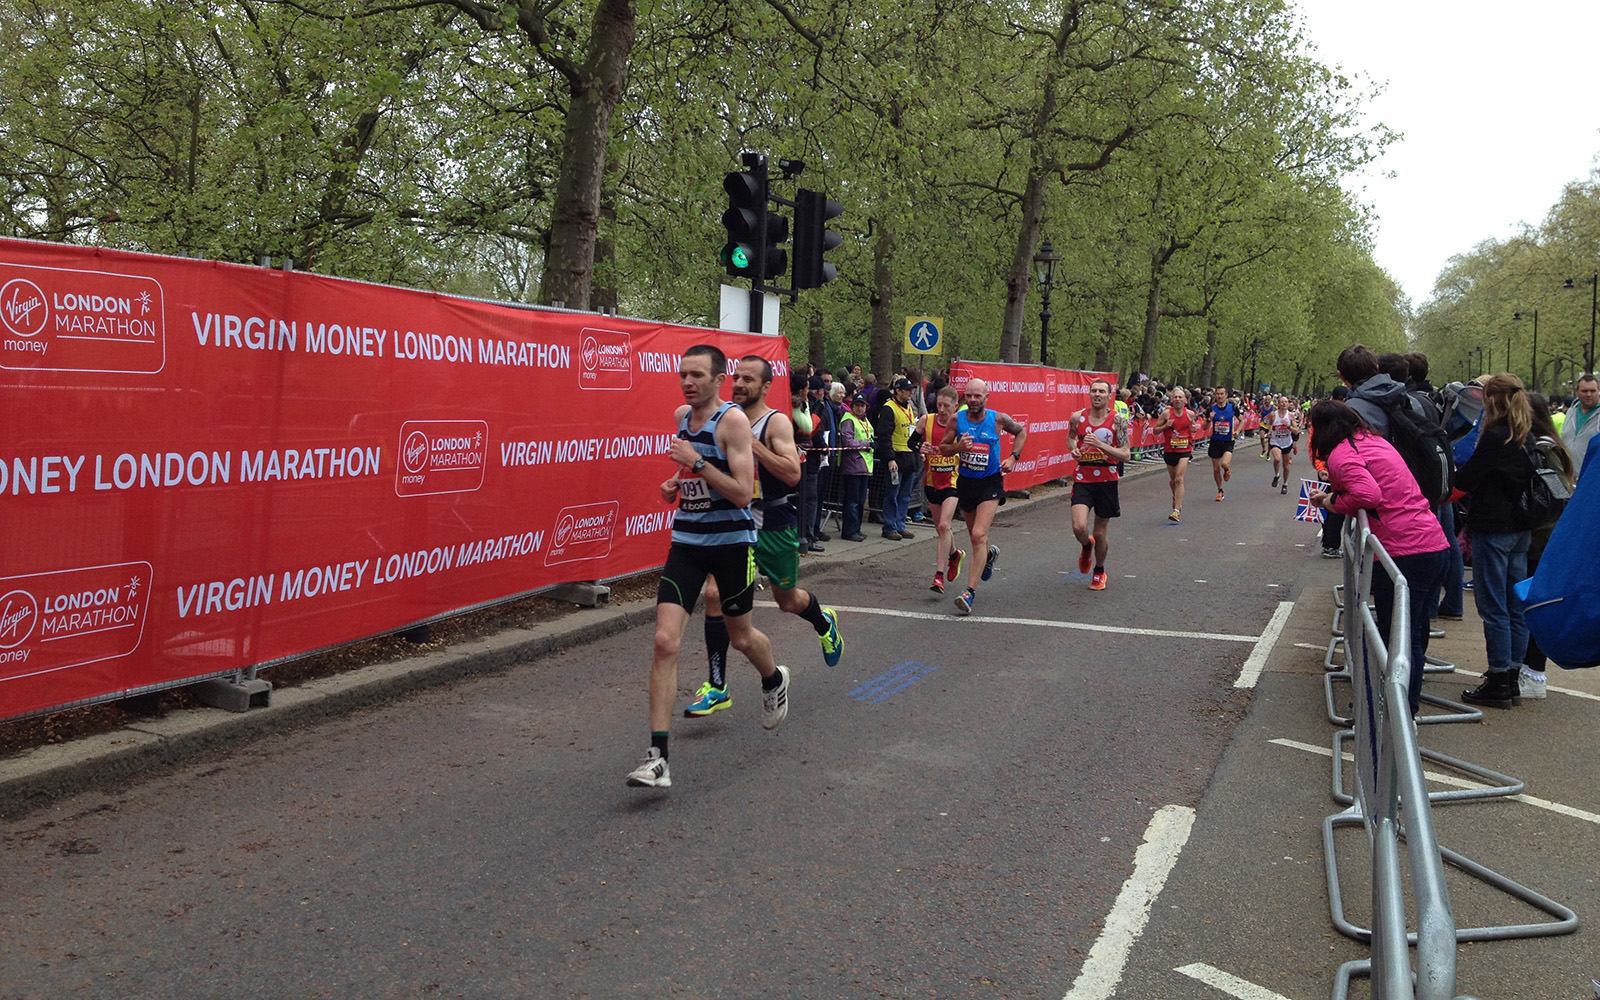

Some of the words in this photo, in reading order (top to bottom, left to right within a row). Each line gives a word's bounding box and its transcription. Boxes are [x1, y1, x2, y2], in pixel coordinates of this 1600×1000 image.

[6, 288, 41, 326] Virgin
[54, 293, 131, 314] LONDON
[55, 315, 156, 337] MARATHON
[4, 339, 48, 355] money
[192, 311, 297, 351] VIRGIN
[305, 322, 386, 357] MONEY
[394, 330, 472, 363] LONDON
[478, 338, 570, 369] MARATHON
[600, 356, 630, 368] MARATHON
[638, 351, 671, 373] VIRGIN
[431, 438, 471, 451] LONDON
[500, 440, 551, 467] VIRGIN
[555, 438, 604, 463] MONEY
[604, 435, 653, 459] LONDON
[95, 451, 231, 490] LONDON
[240, 446, 381, 482] MARATHON
[430, 452, 482, 466] MARATHON
[402, 475, 425, 485] money
[571, 526, 611, 541] MARATHON
[574, 516, 605, 529] LONDON
[625, 511, 665, 536] VIRGIN
[177, 573, 275, 618] VIRGIN
[280, 558, 370, 602] MONEY
[373, 544, 456, 585] LONDON
[455, 529, 545, 568] MARATHON
[44, 587, 120, 614] LONDON
[41, 604, 139, 635] MARATHON
